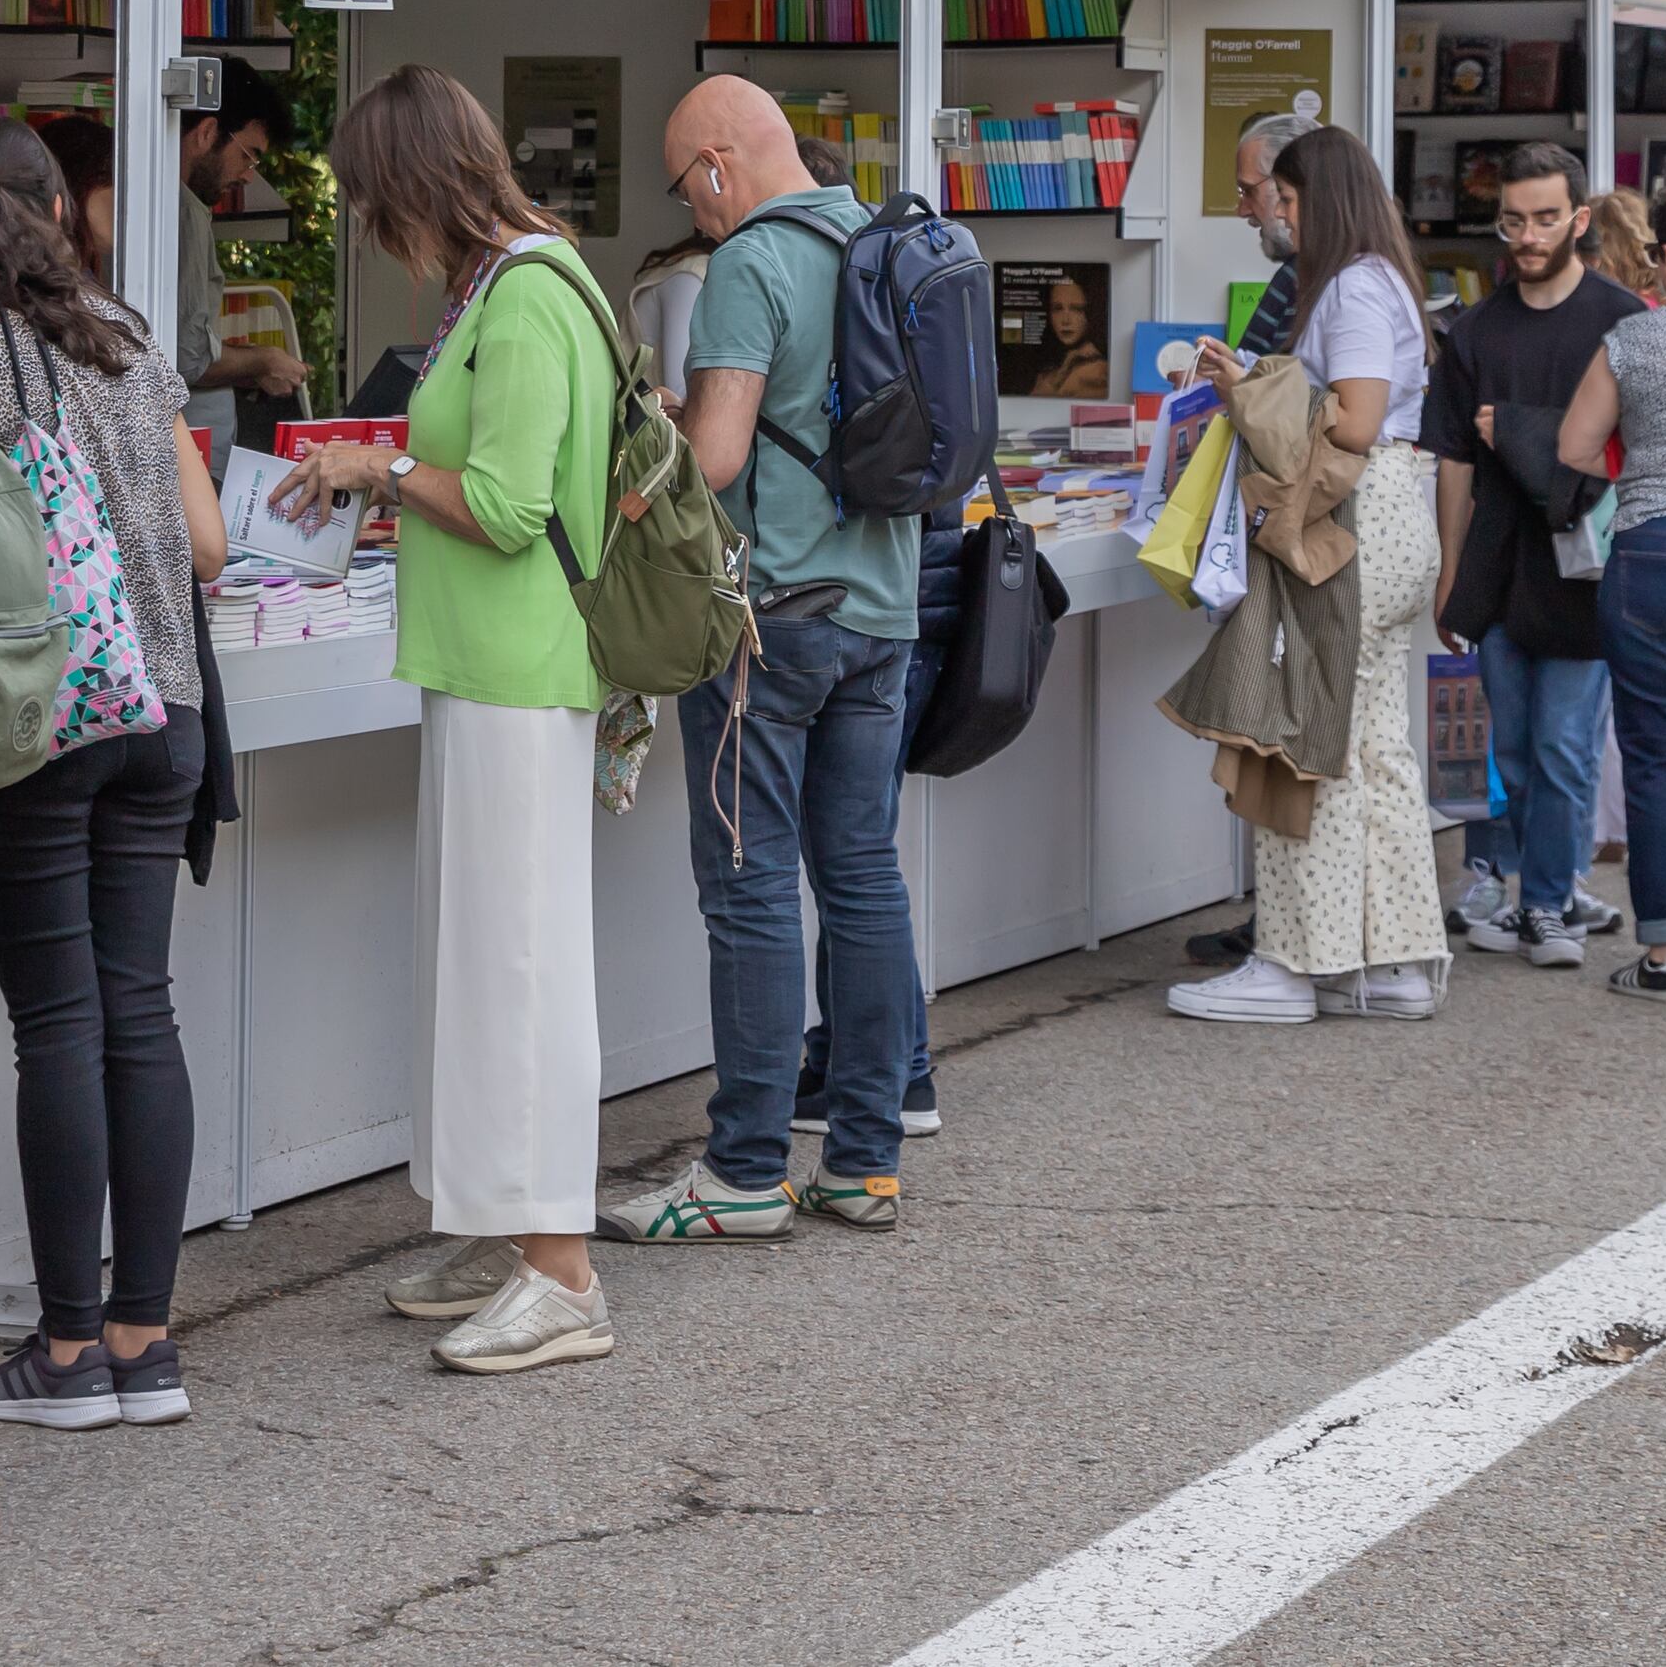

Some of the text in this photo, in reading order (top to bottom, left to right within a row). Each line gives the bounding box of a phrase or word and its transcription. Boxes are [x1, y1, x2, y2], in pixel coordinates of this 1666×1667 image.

[1211, 39, 1253, 52] Maggie
[239, 516, 252, 542] Saltaré
[246, 495, 255, 516] sobre
[252, 485, 258, 494] el
